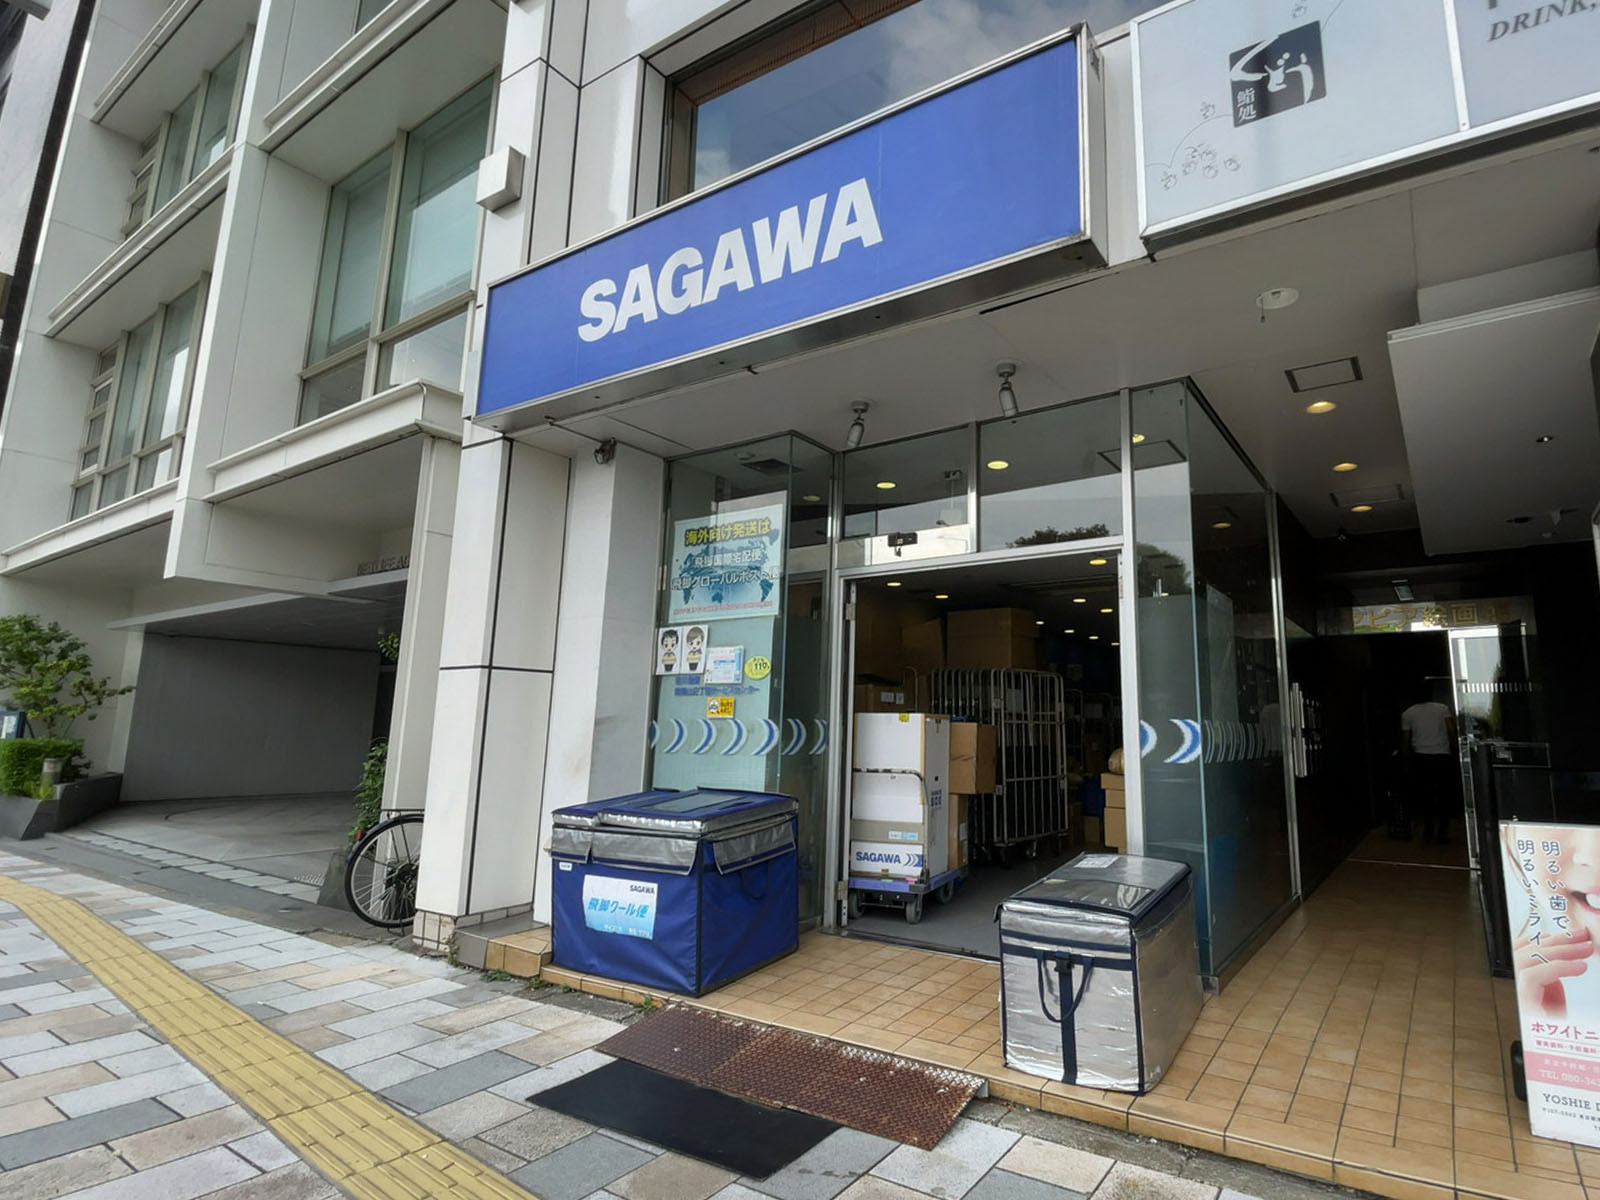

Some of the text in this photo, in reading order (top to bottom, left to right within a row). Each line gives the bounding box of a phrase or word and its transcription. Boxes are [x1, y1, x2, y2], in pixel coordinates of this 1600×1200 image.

[1236, 87, 1257, 123] 鮨処
[577, 177, 884, 343] SAGAWA
[685, 518, 771, 546] 海外向け発送は
[855, 851, 902, 864] SAGAWA
[629, 884, 655, 894] SAGAWA
[1541, 841, 1571, 937] 明るい歯で、
[588, 897, 650, 919] 飛脚クール便
[1517, 840, 1549, 964] 明るいミライへ
[1540, 1069, 1559, 1081] TEL
[1542, 1092, 1592, 1111] YOSHIE
